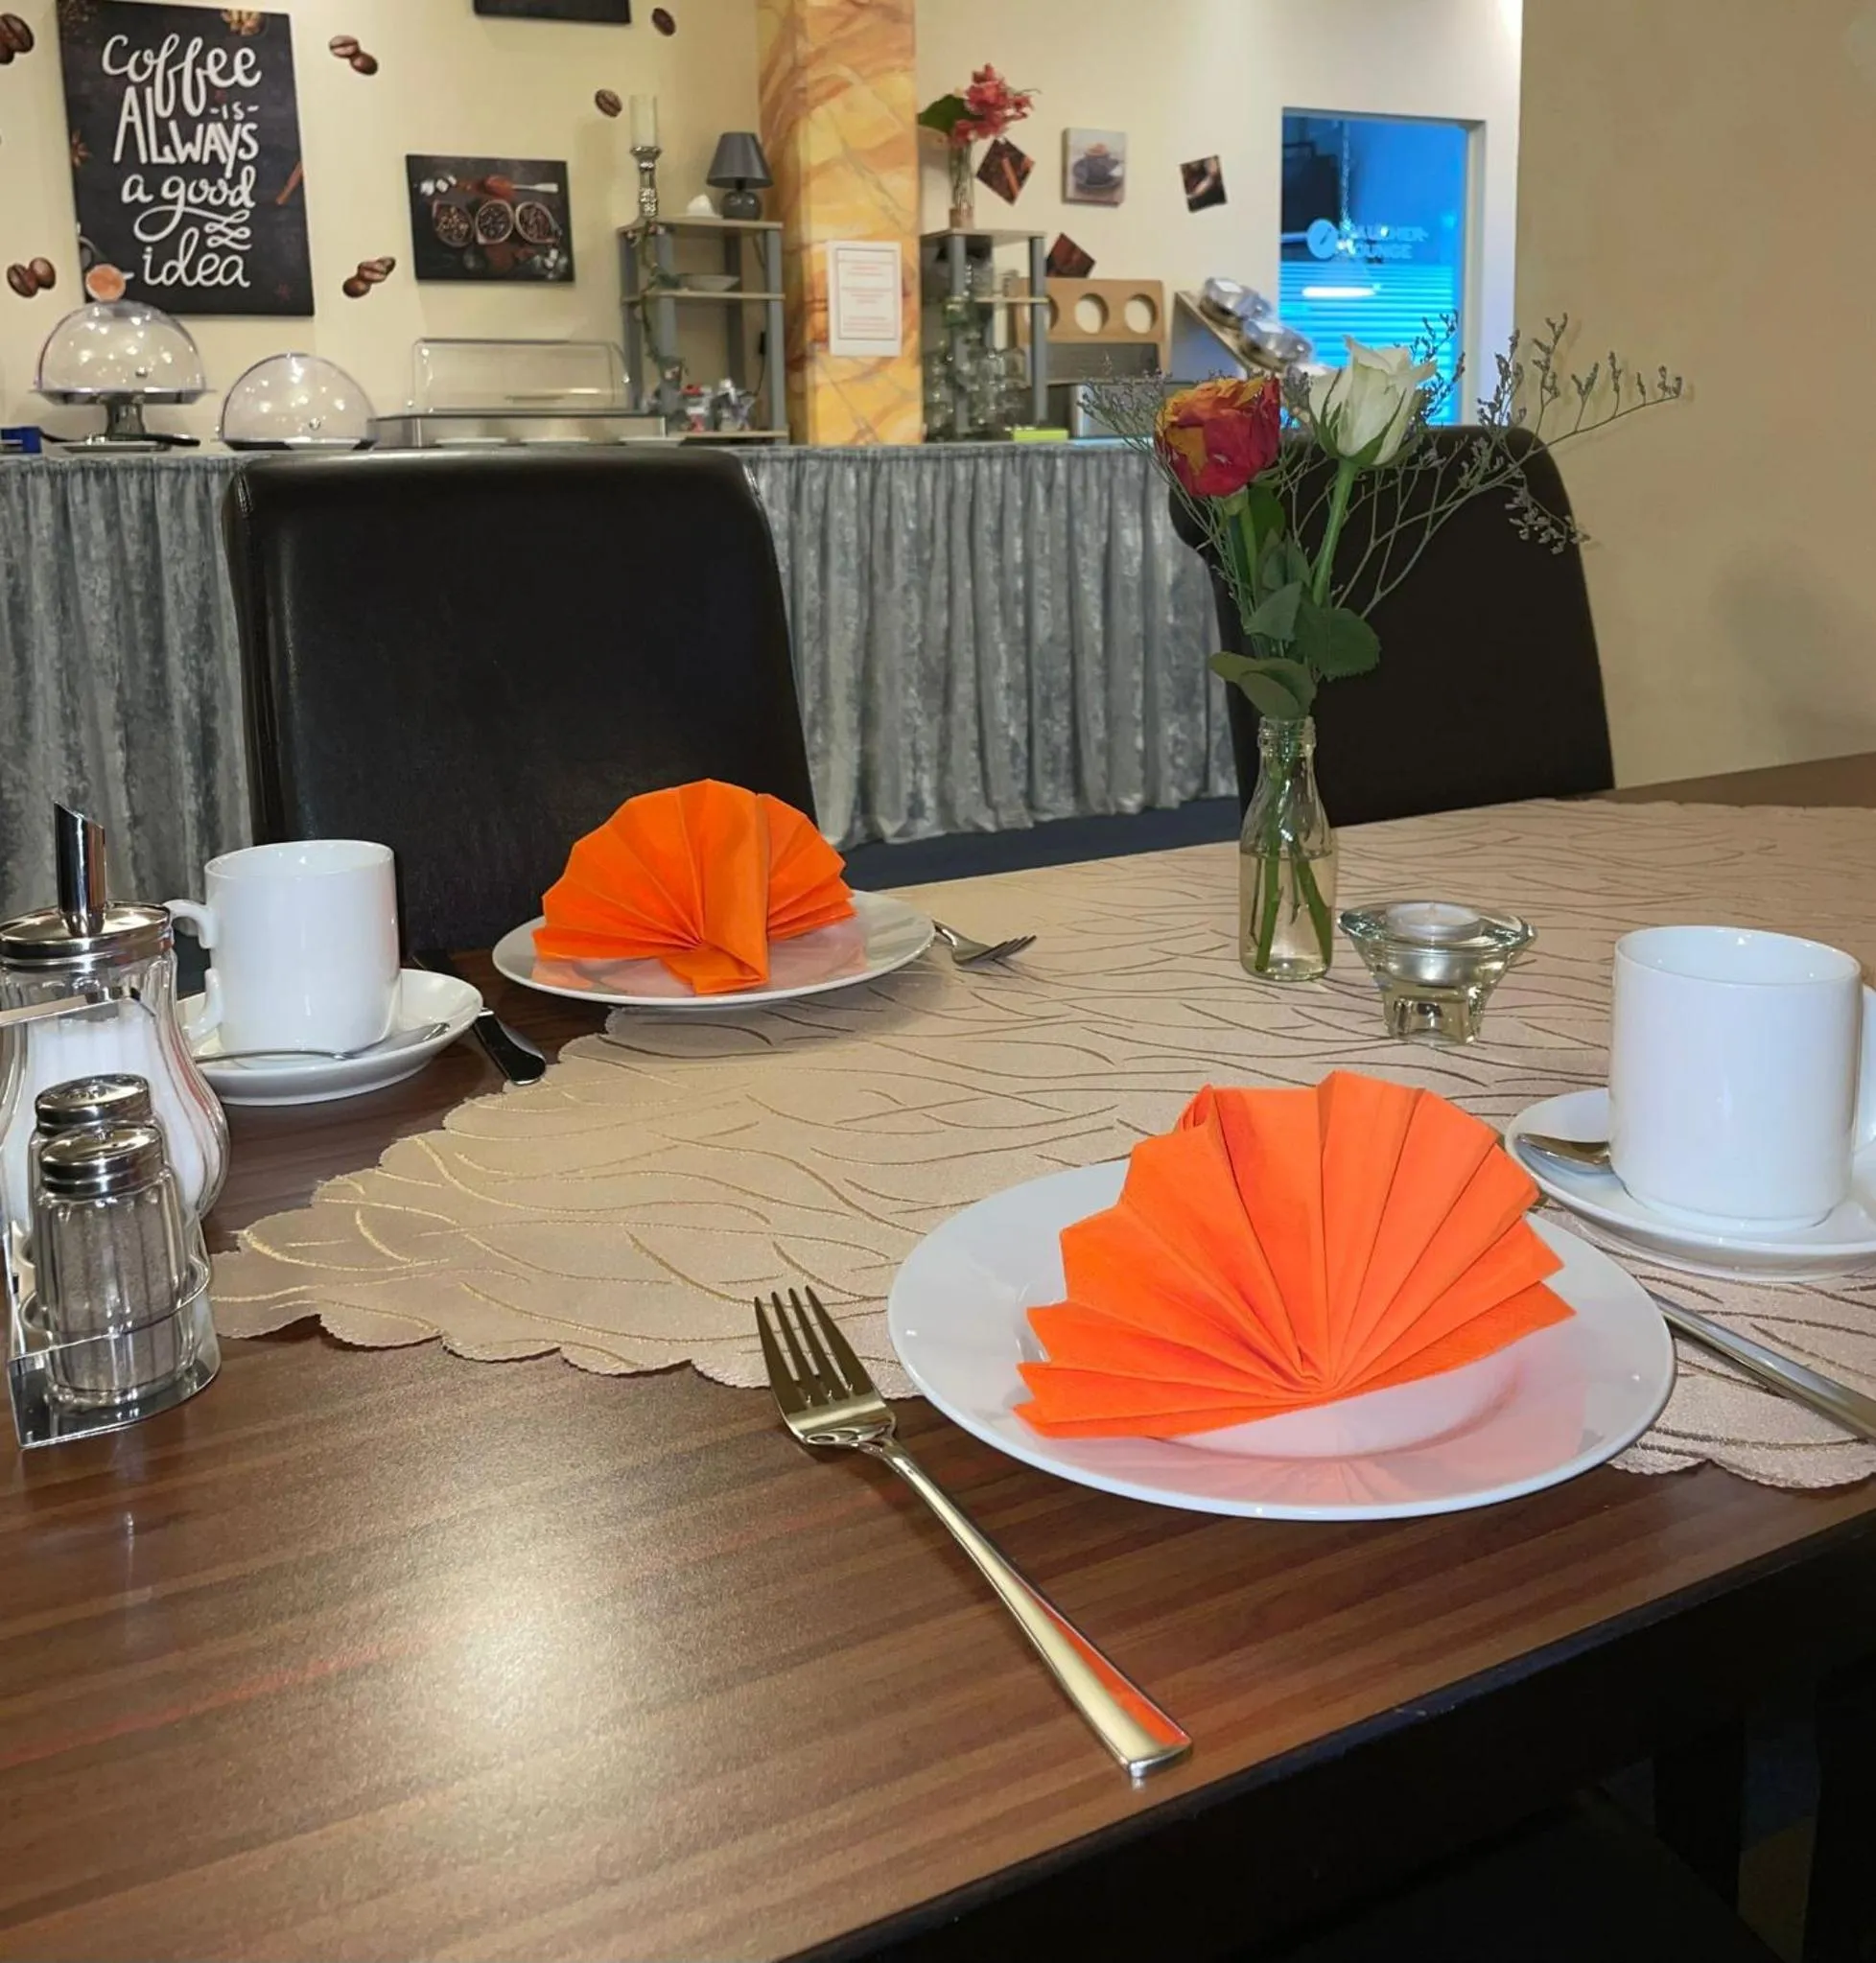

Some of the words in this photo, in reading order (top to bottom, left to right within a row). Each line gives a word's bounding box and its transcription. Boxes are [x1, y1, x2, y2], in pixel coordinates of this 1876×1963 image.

[102, 33, 262, 118] Coffee
[113, 85, 258, 179] ALWAYS
[122, 174, 153, 203] a
[133, 165, 256, 243] good
[143, 227, 250, 288] idea
